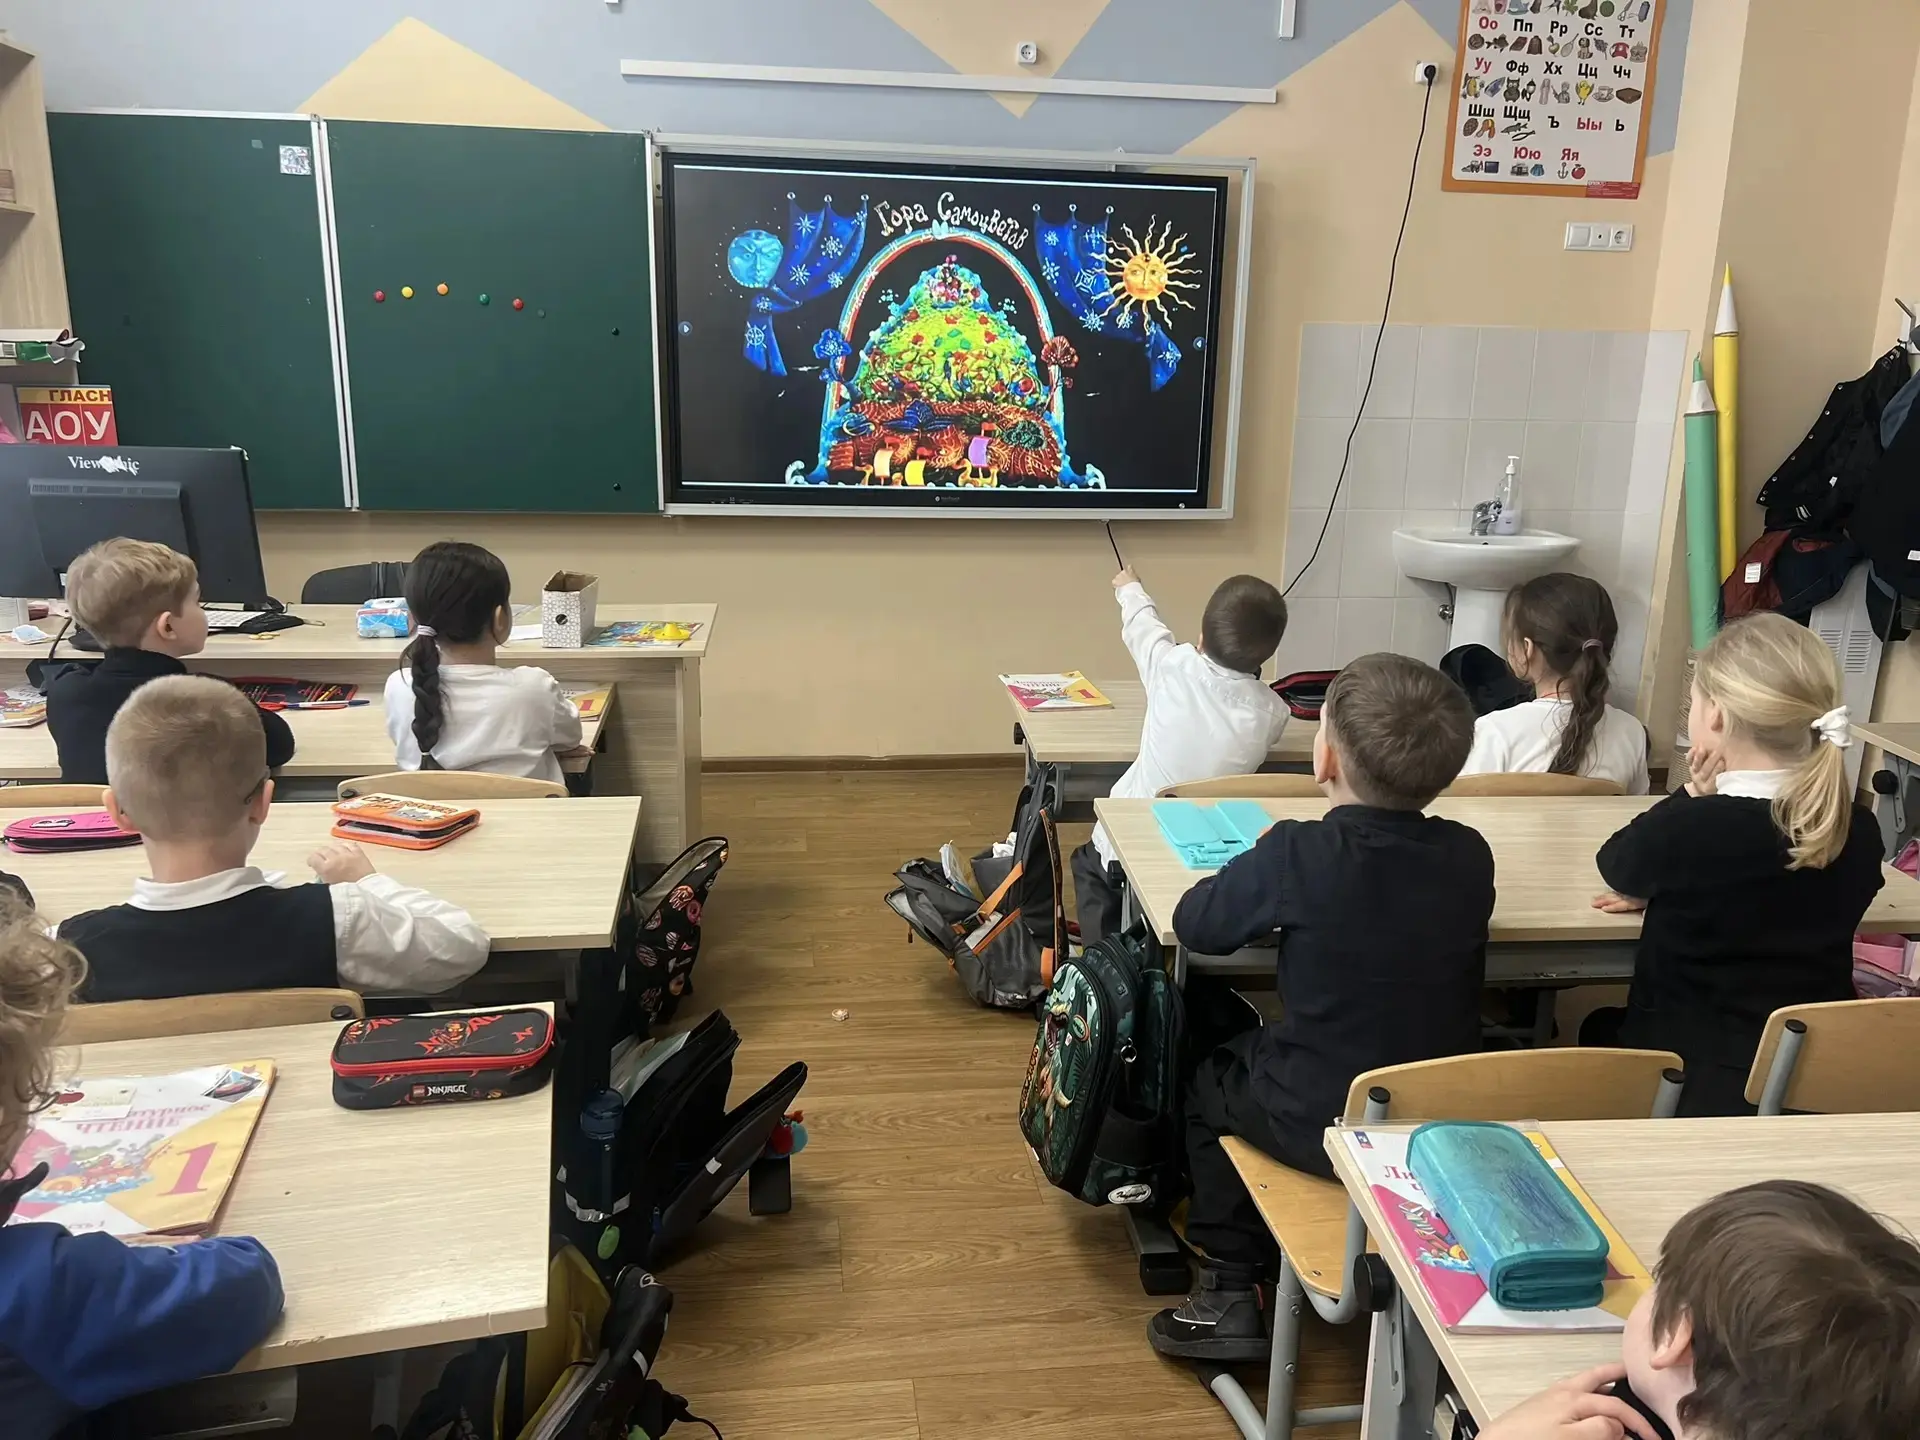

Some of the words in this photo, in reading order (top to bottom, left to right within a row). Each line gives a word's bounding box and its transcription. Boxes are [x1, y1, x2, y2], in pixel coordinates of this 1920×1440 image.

[1478, 16, 1499, 30] Оо
[1513, 19, 1533, 32] Пп
[1550, 21, 1568, 36] Рр
[1584, 23, 1603, 37] Сс
[1619, 25, 1635, 38] Тт
[1474, 57, 1492, 74] Уу
[1505, 60, 1529, 76] Фф
[1543, 61, 1563, 75] Хх
[1578, 63, 1598, 79] Цц
[1613, 65, 1631, 79] Чч
[1468, 104, 1495, 118] Шш
[1503, 106, 1531, 121] Щщ
[1548, 116, 1560, 129] Ъ
[1576, 118, 1602, 131] Ыы
[1615, 119, 1625, 132] Ь
[1473, 144, 1492, 157] Ээ
[1513, 147, 1541, 160] Юю
[1561, 148, 1579, 161] Яя
[873, 200, 929, 237] Гора
[937, 191, 1029, 250] Самоцветов
[50, 389, 111, 402] ГЛАСН
[427, 1084, 468, 1097] NINJAGO
[156, 1141, 219, 1197] 1
